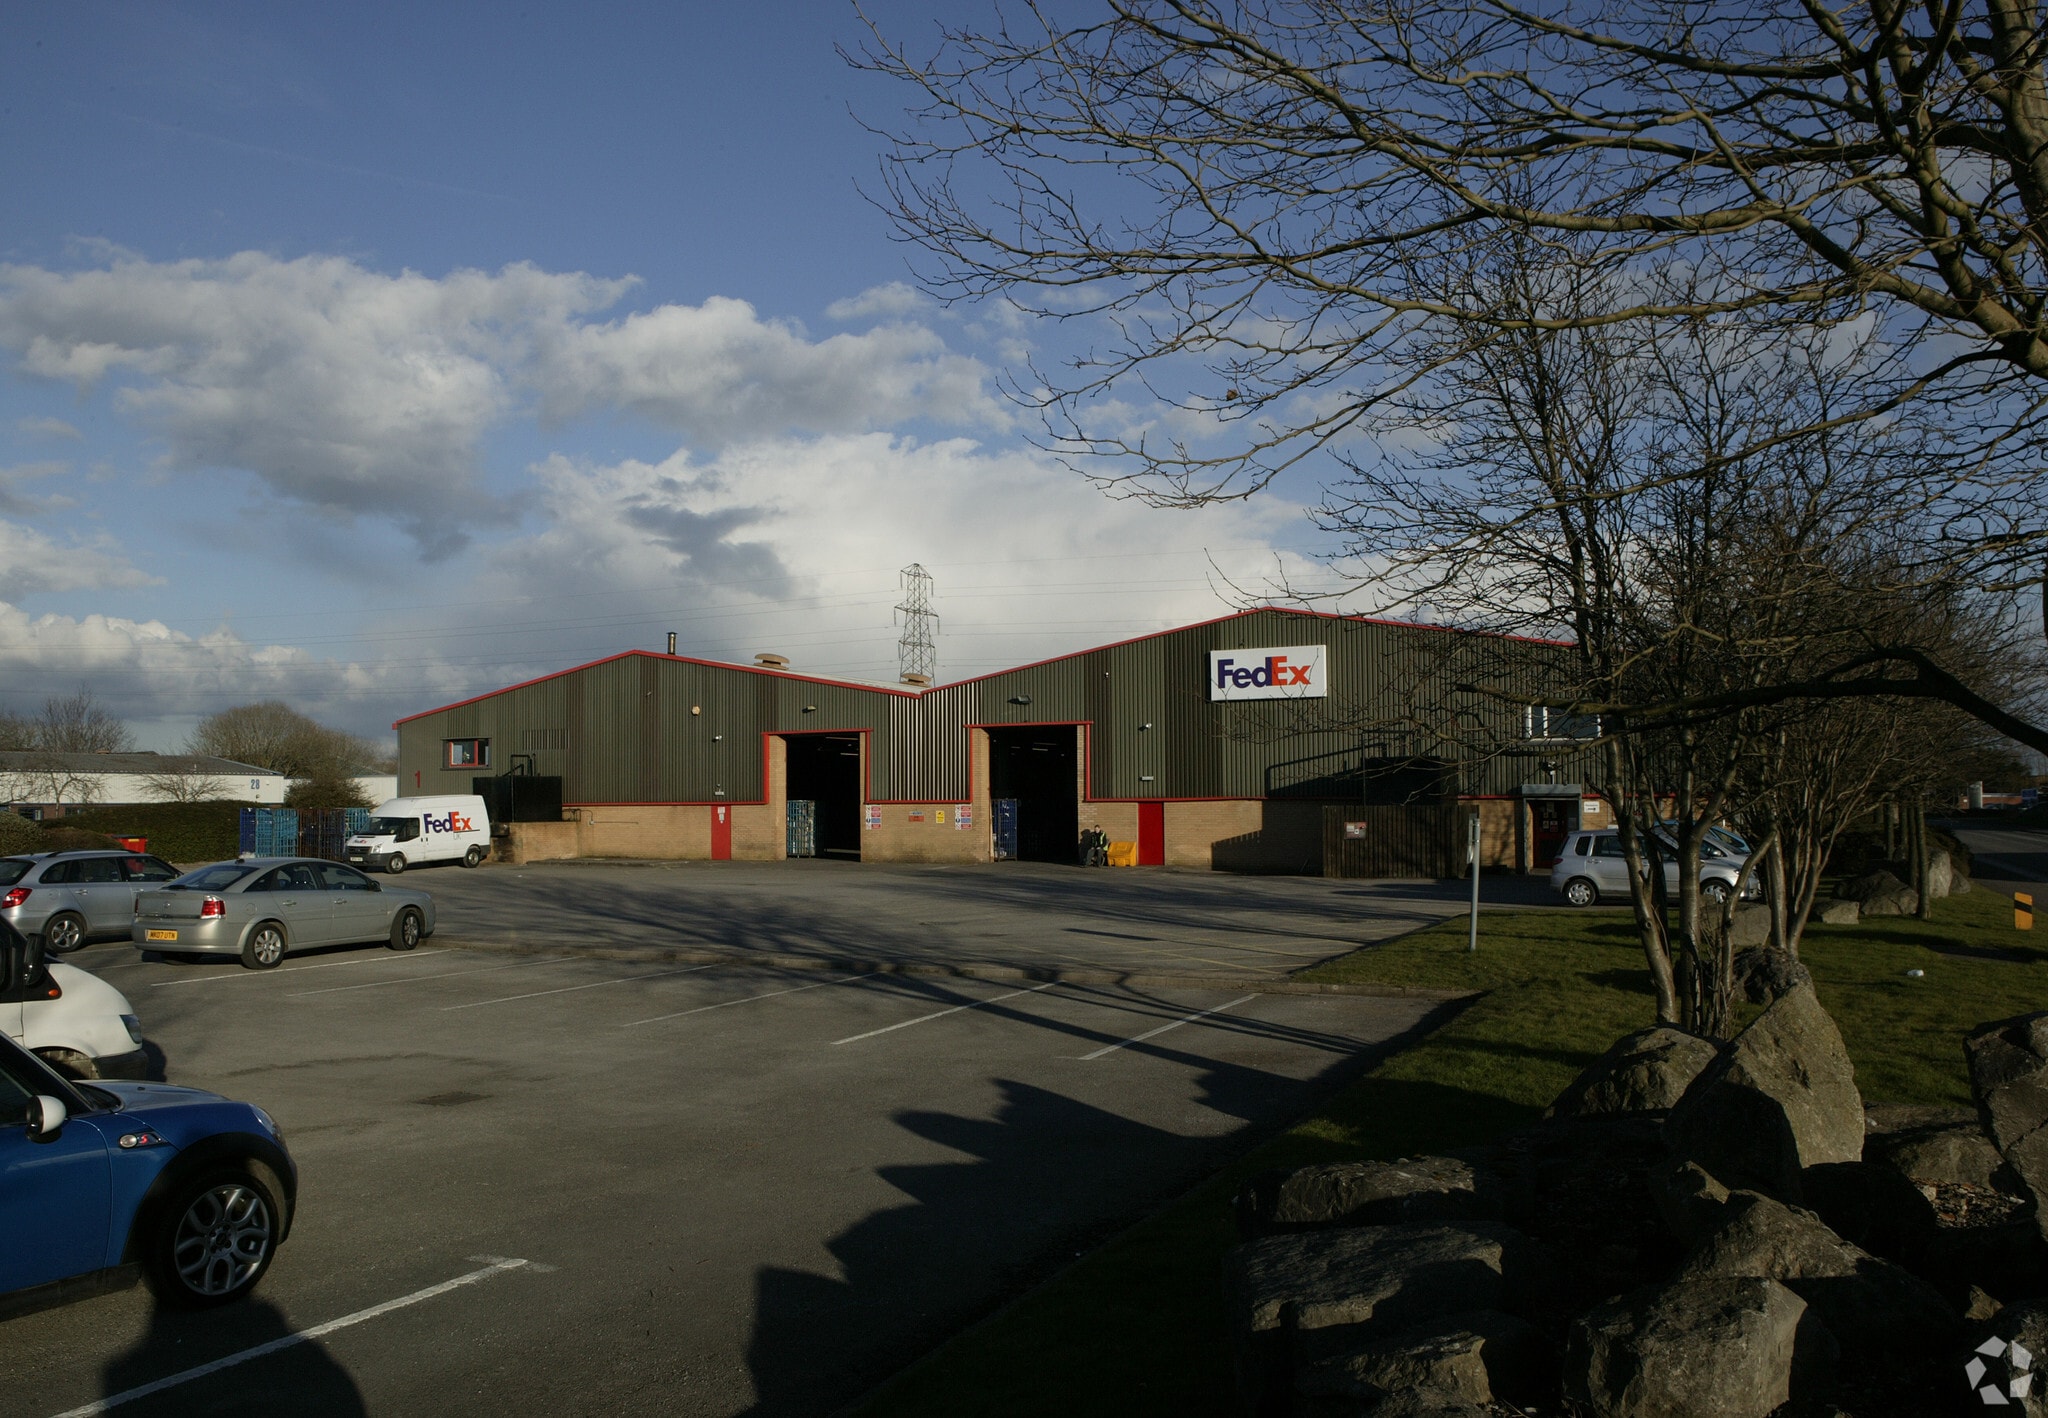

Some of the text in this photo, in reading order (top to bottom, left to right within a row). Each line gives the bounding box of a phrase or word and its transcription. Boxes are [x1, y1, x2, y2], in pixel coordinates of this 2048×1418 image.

[1218, 655, 1311, 688] FedEx
[251, 779, 260, 789] 28
[415, 770, 421, 788] 1
[423, 811, 473, 833] FedEx
